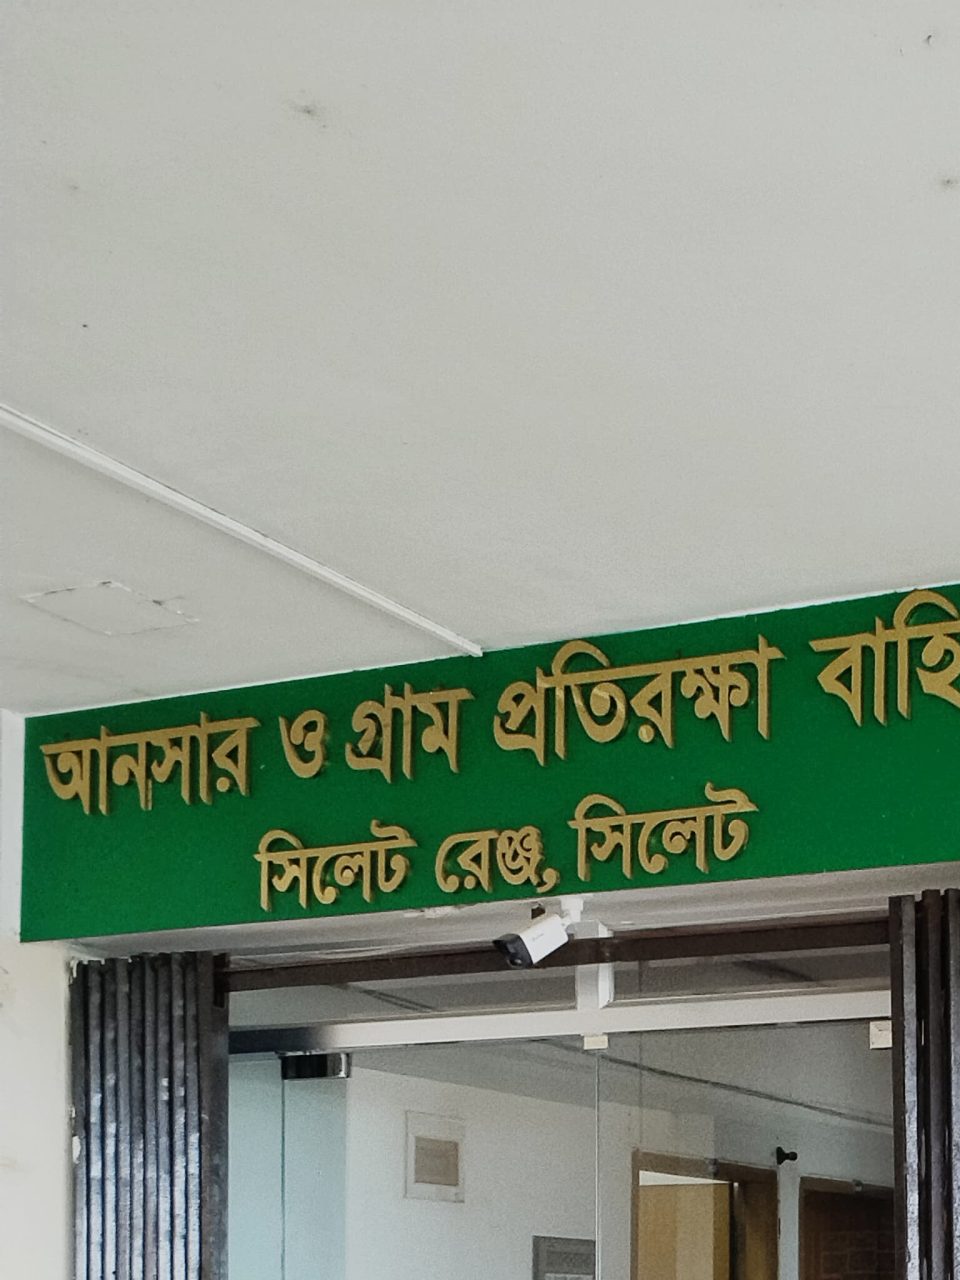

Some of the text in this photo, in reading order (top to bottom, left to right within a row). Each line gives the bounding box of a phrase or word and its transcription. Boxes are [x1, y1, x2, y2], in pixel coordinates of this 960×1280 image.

[40, 711, 260, 815] আনসার
[279, 709, 328, 779] ও
[345, 682, 475, 784] গ্রাম
[493, 635, 786, 766] প্রতিরক্ষা
[254, 819, 417, 912] সিলেট
[568, 782, 759, 882] সিলেট
